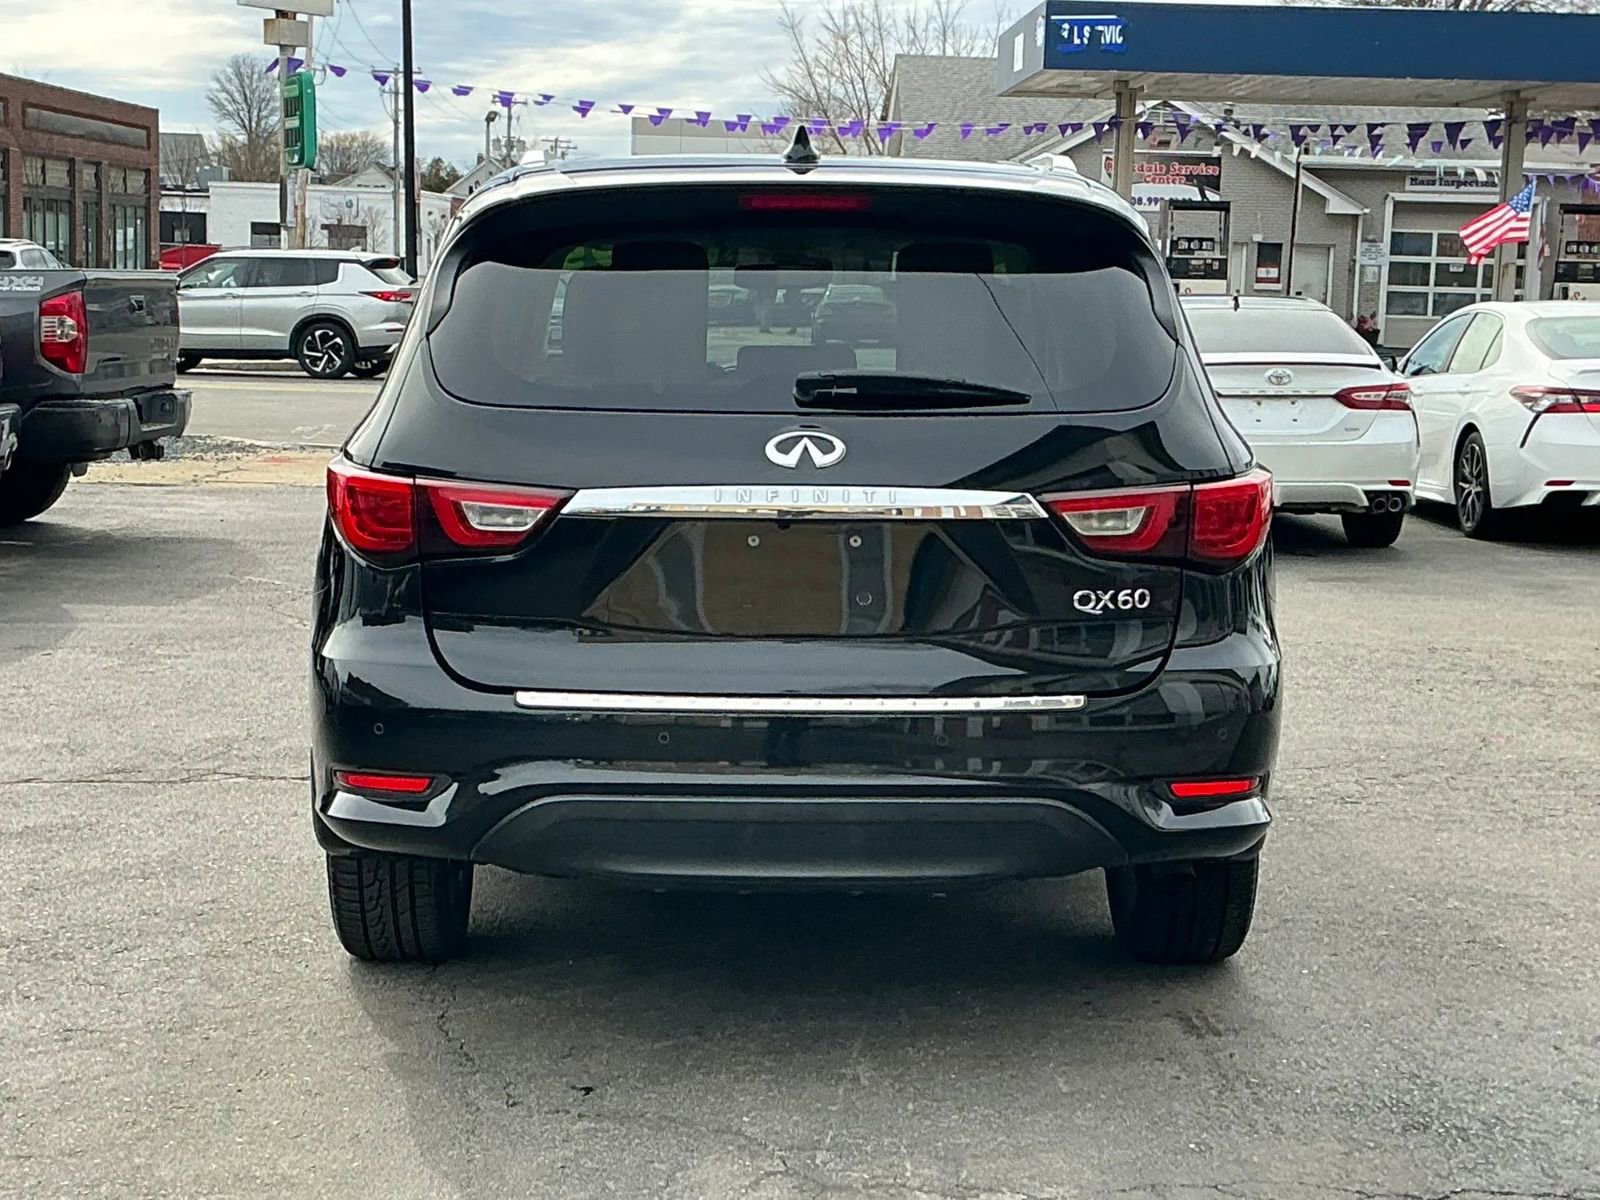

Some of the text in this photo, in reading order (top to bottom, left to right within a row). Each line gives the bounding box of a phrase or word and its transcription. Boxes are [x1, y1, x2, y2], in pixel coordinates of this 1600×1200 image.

[1169, 162, 1220, 176] Service
[1143, 174, 1187, 185] Center
[714, 488, 897, 504] INFINITI
[1072, 588, 1151, 615] QX60
